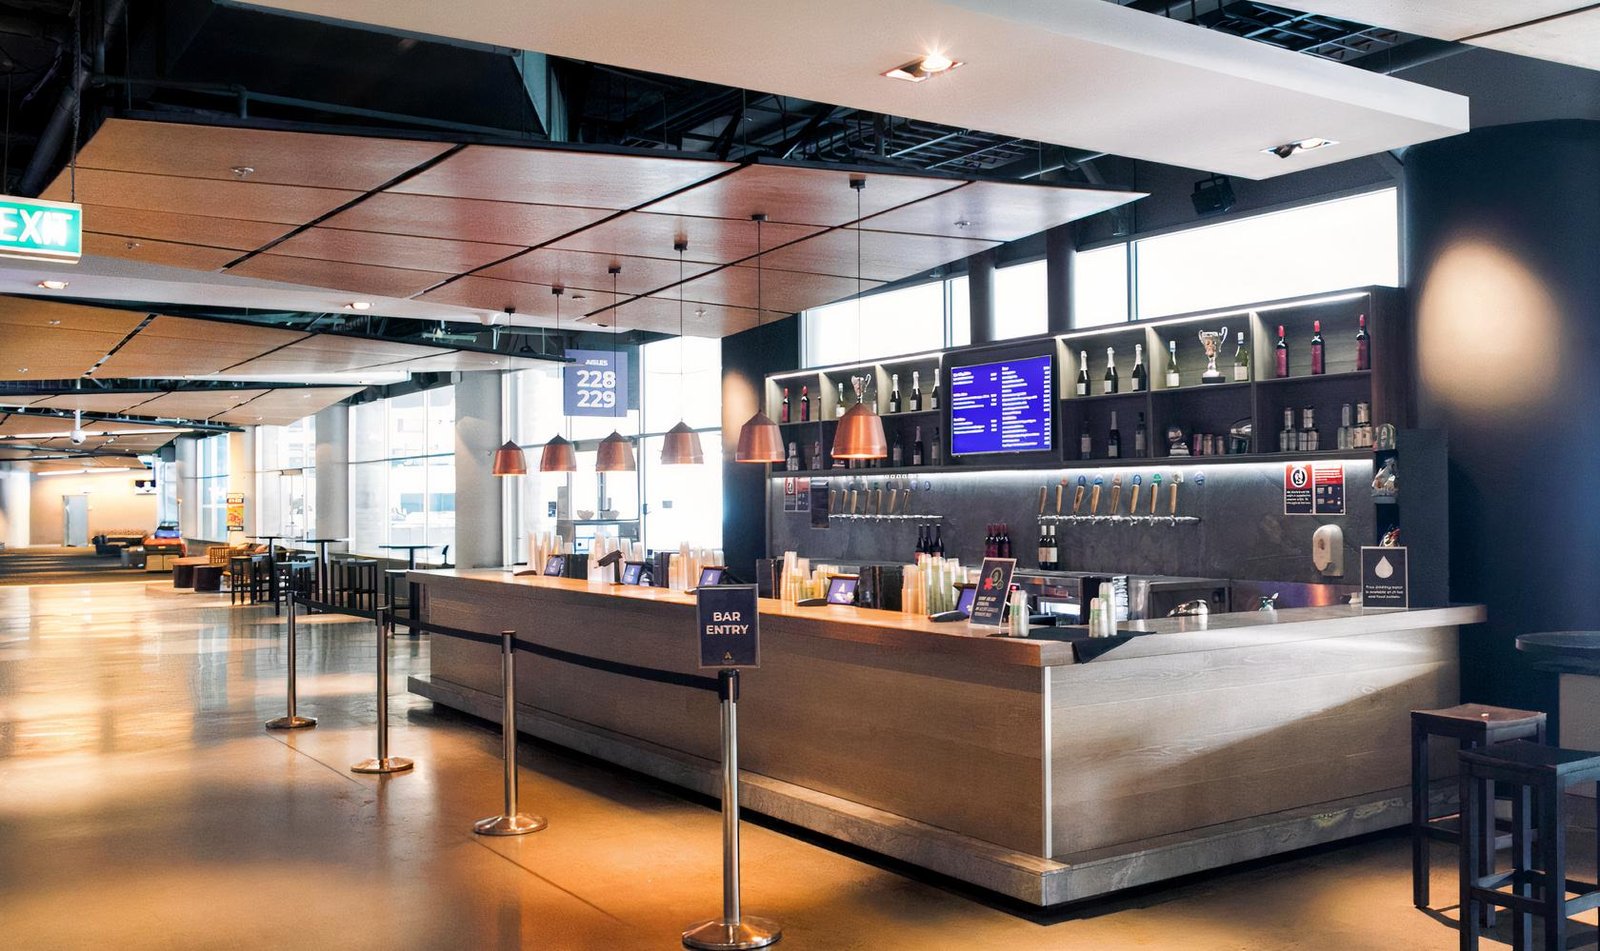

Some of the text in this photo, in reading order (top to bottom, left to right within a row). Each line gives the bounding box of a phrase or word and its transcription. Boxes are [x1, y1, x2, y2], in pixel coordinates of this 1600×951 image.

[0, 206, 74, 247] EXIT
[576, 369, 616, 388] 228
[576, 389, 616, 408] 229
[713, 611, 741, 622] BAR
[706, 624, 749, 635] ENTRY
